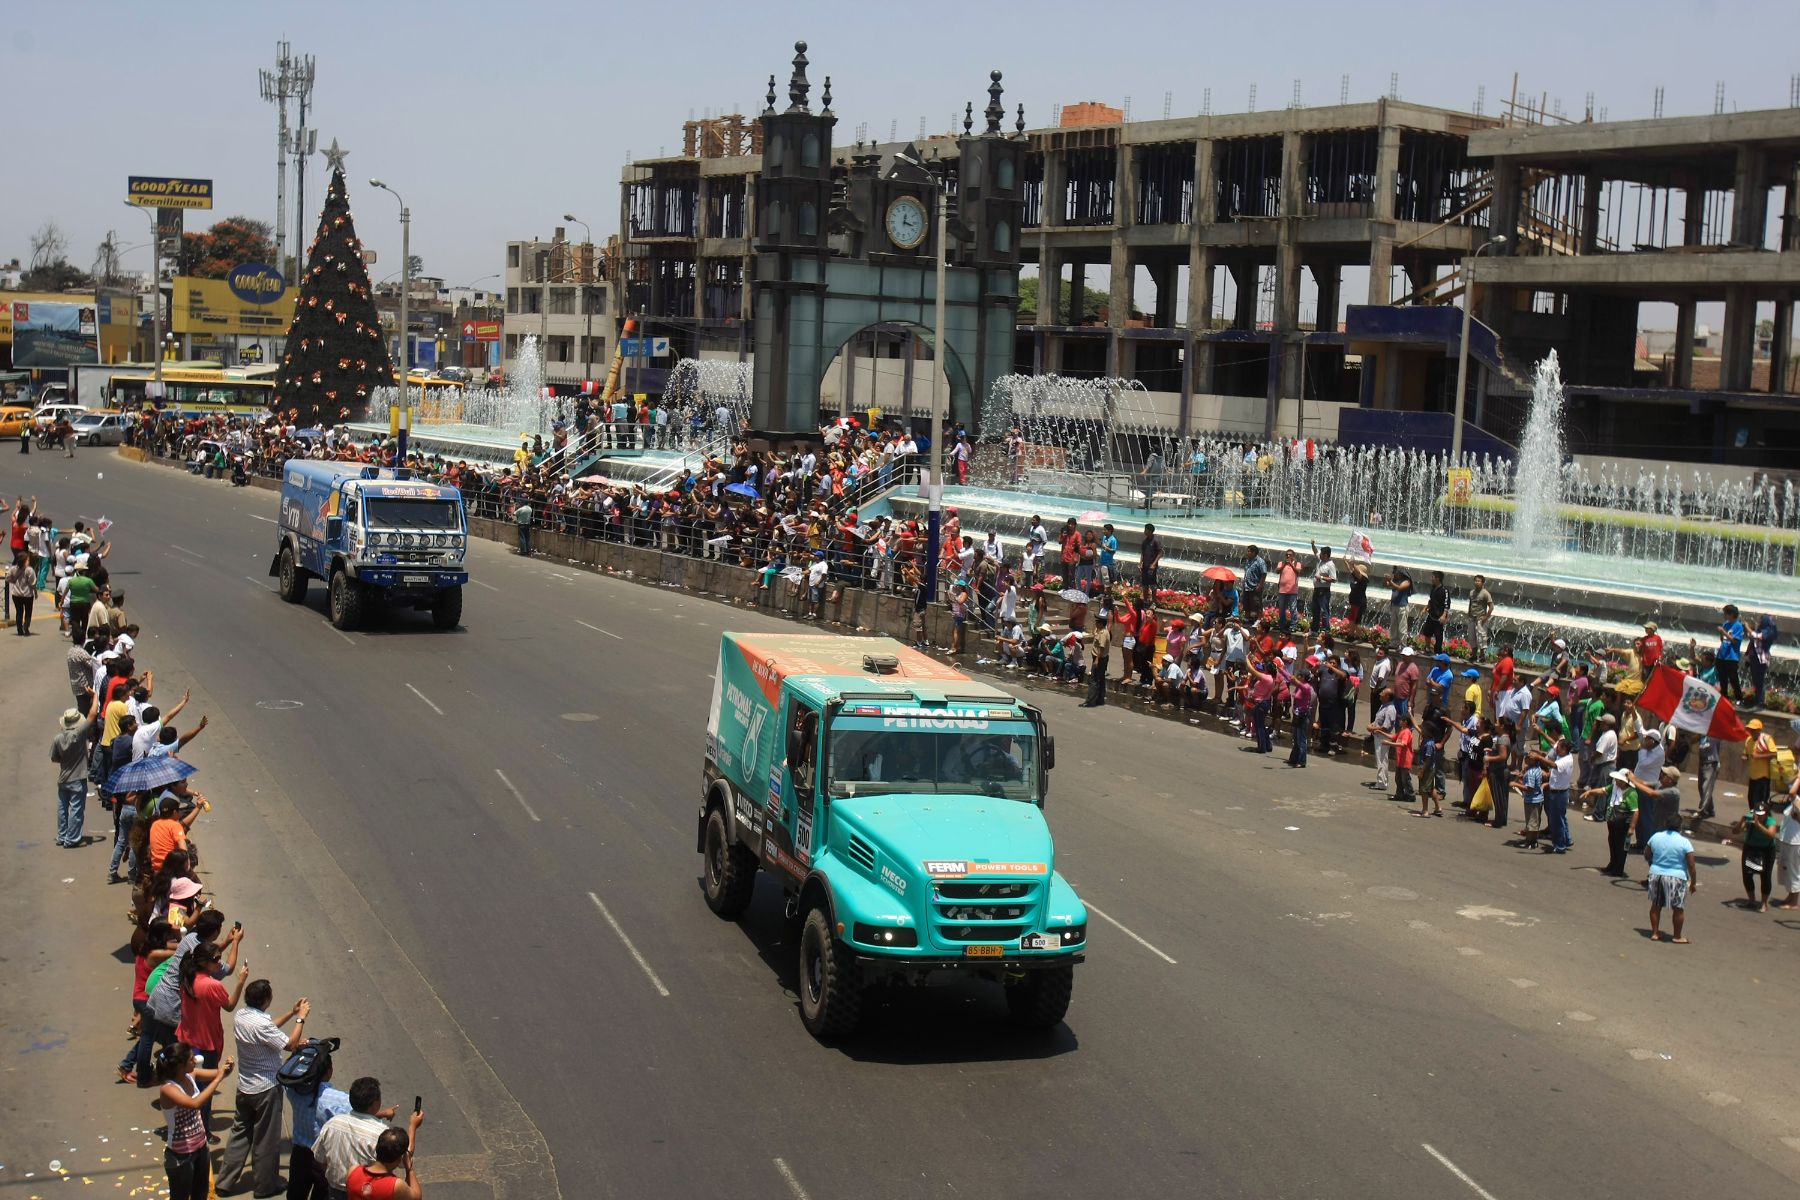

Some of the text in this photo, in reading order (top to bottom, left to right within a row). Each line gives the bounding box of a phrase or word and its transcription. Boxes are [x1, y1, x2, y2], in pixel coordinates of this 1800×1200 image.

[131, 180, 208, 194] GOODYEAR
[136, 197, 203, 207] Tecnillantas
[234, 271, 281, 293] GOODYEAR
[288, 506, 300, 529] VTB
[727, 681, 753, 719] PETRONAS
[883, 706, 989, 730] PETRONAS
[737, 793, 753, 818] IVECO
[797, 823, 810, 850] 500
[881, 865, 907, 890] IVECO
[927, 862, 966, 873] FERM
